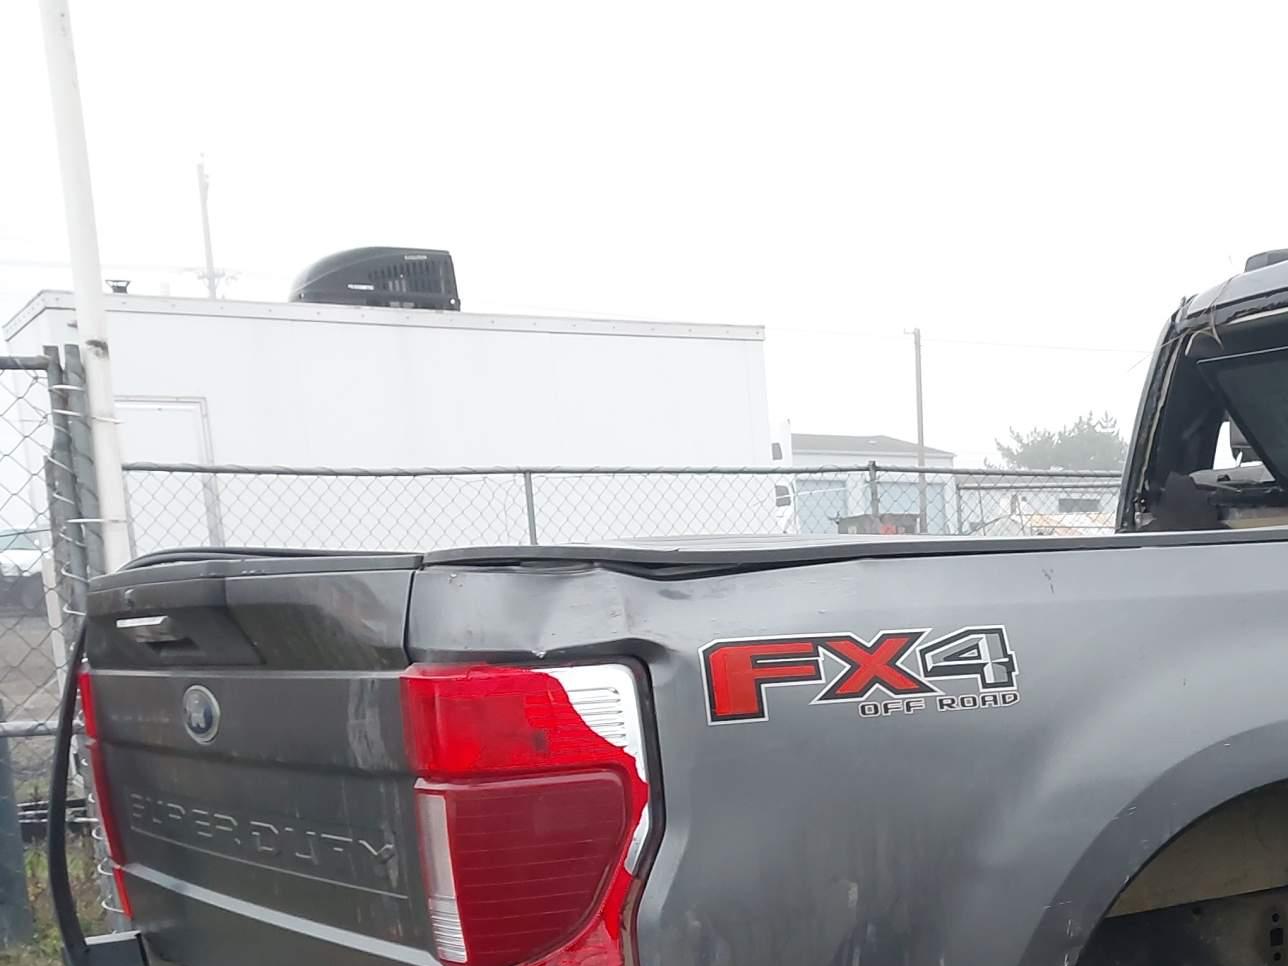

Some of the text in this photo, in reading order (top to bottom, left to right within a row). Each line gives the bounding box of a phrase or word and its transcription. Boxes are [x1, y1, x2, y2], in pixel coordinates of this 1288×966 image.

[698, 625, 1020, 726] FX4
[858, 690, 1021, 719] OFF ROAD
[250, 820, 395, 865] DUTY
